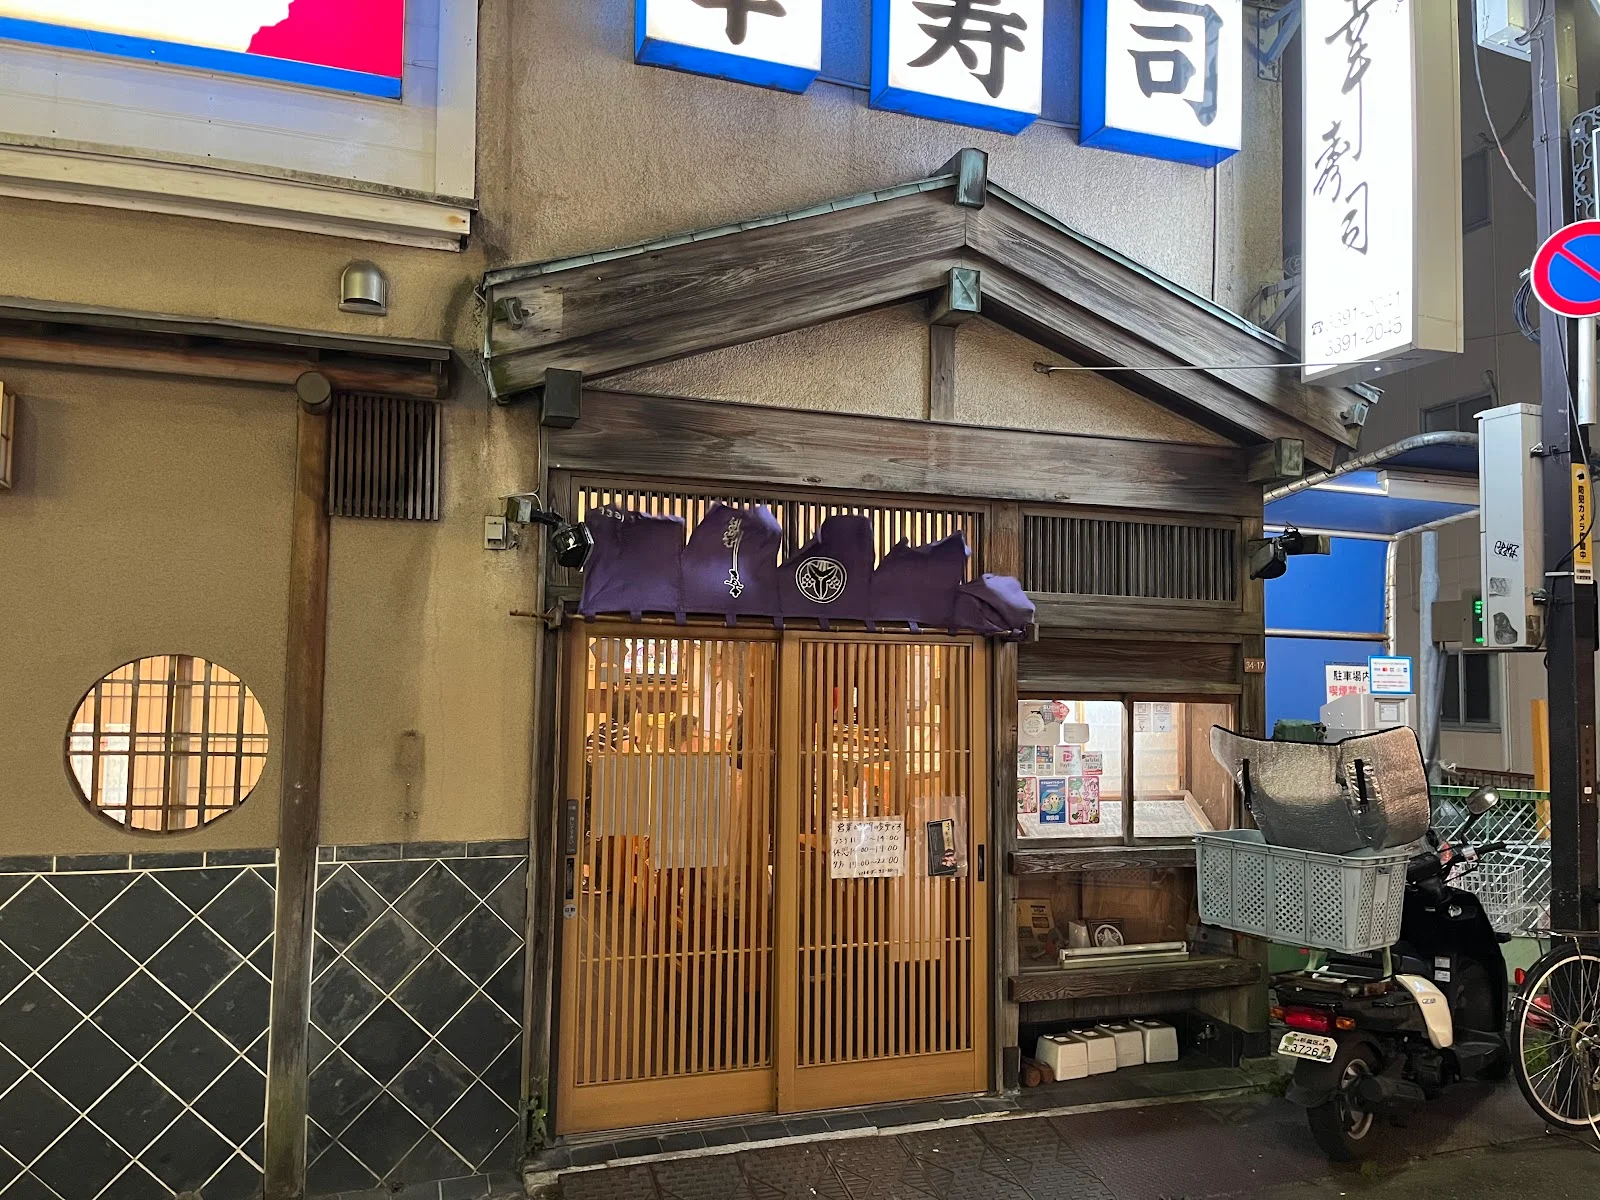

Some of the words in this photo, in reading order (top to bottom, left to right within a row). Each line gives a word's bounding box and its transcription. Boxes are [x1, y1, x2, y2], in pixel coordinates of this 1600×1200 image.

[1246, 660, 1265, 670] 34-17
[1333, 670, 1370, 682] 駐車場内
[1290, 1043, 1320, 1056] 3726
